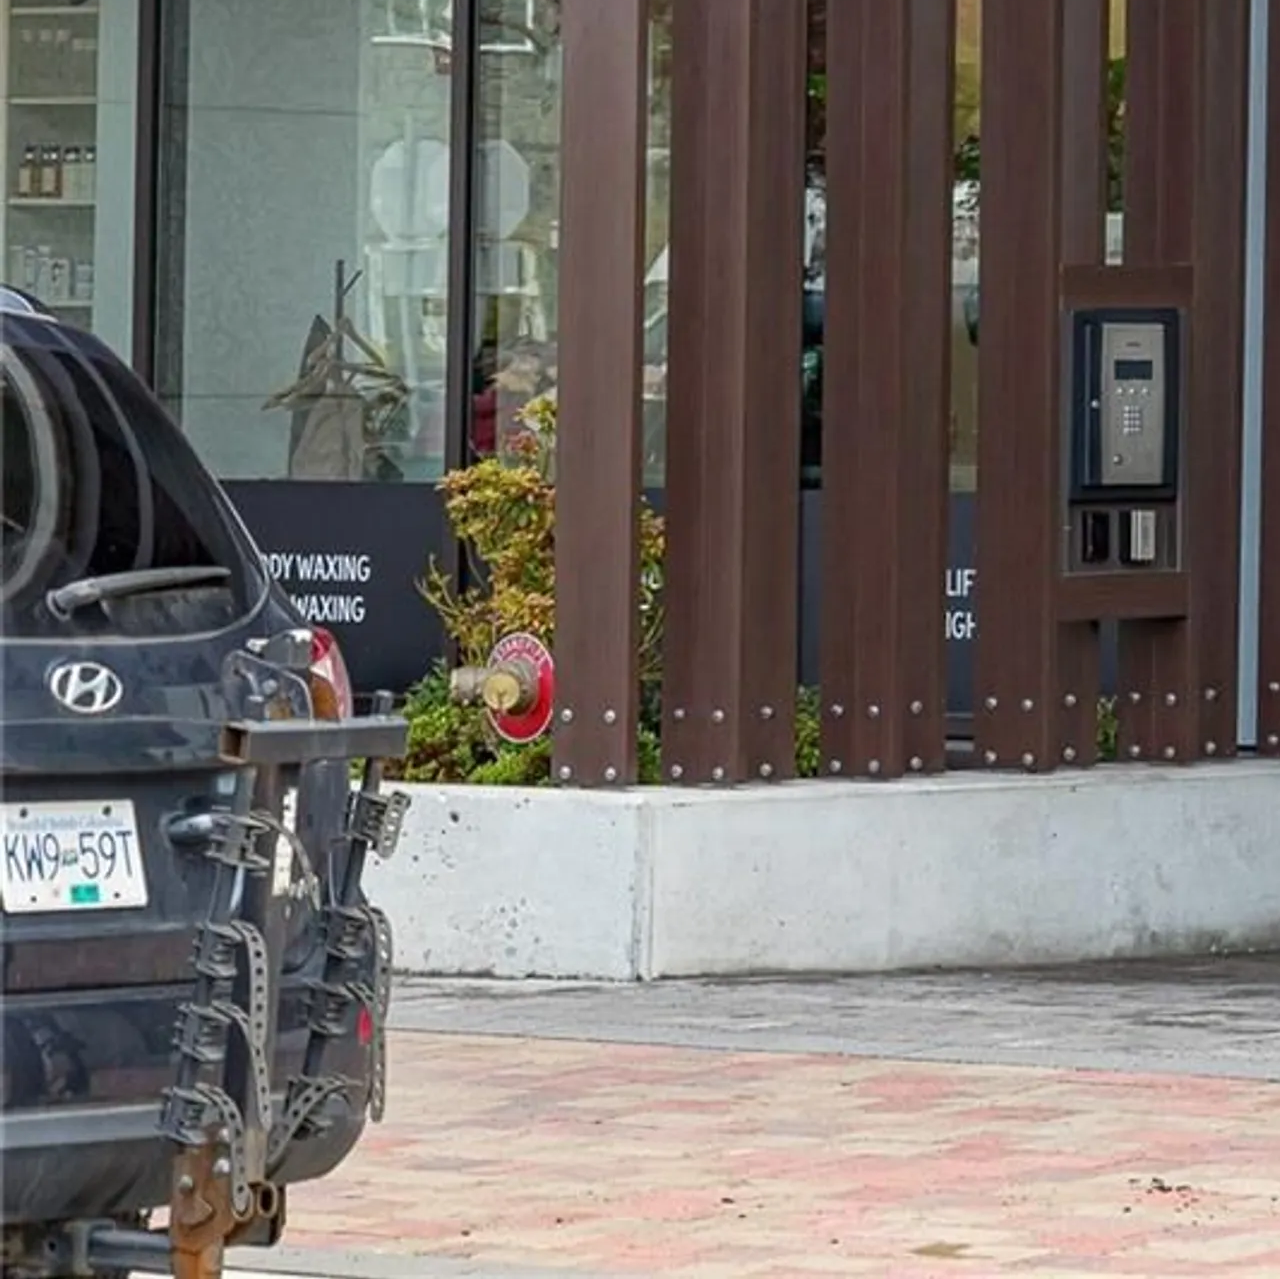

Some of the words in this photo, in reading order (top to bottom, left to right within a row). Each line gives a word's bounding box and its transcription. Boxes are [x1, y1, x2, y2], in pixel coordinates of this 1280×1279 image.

[295, 553, 371, 584] WAXING
[4, 832, 61, 882] KW9
[78, 829, 133, 880] 59T
